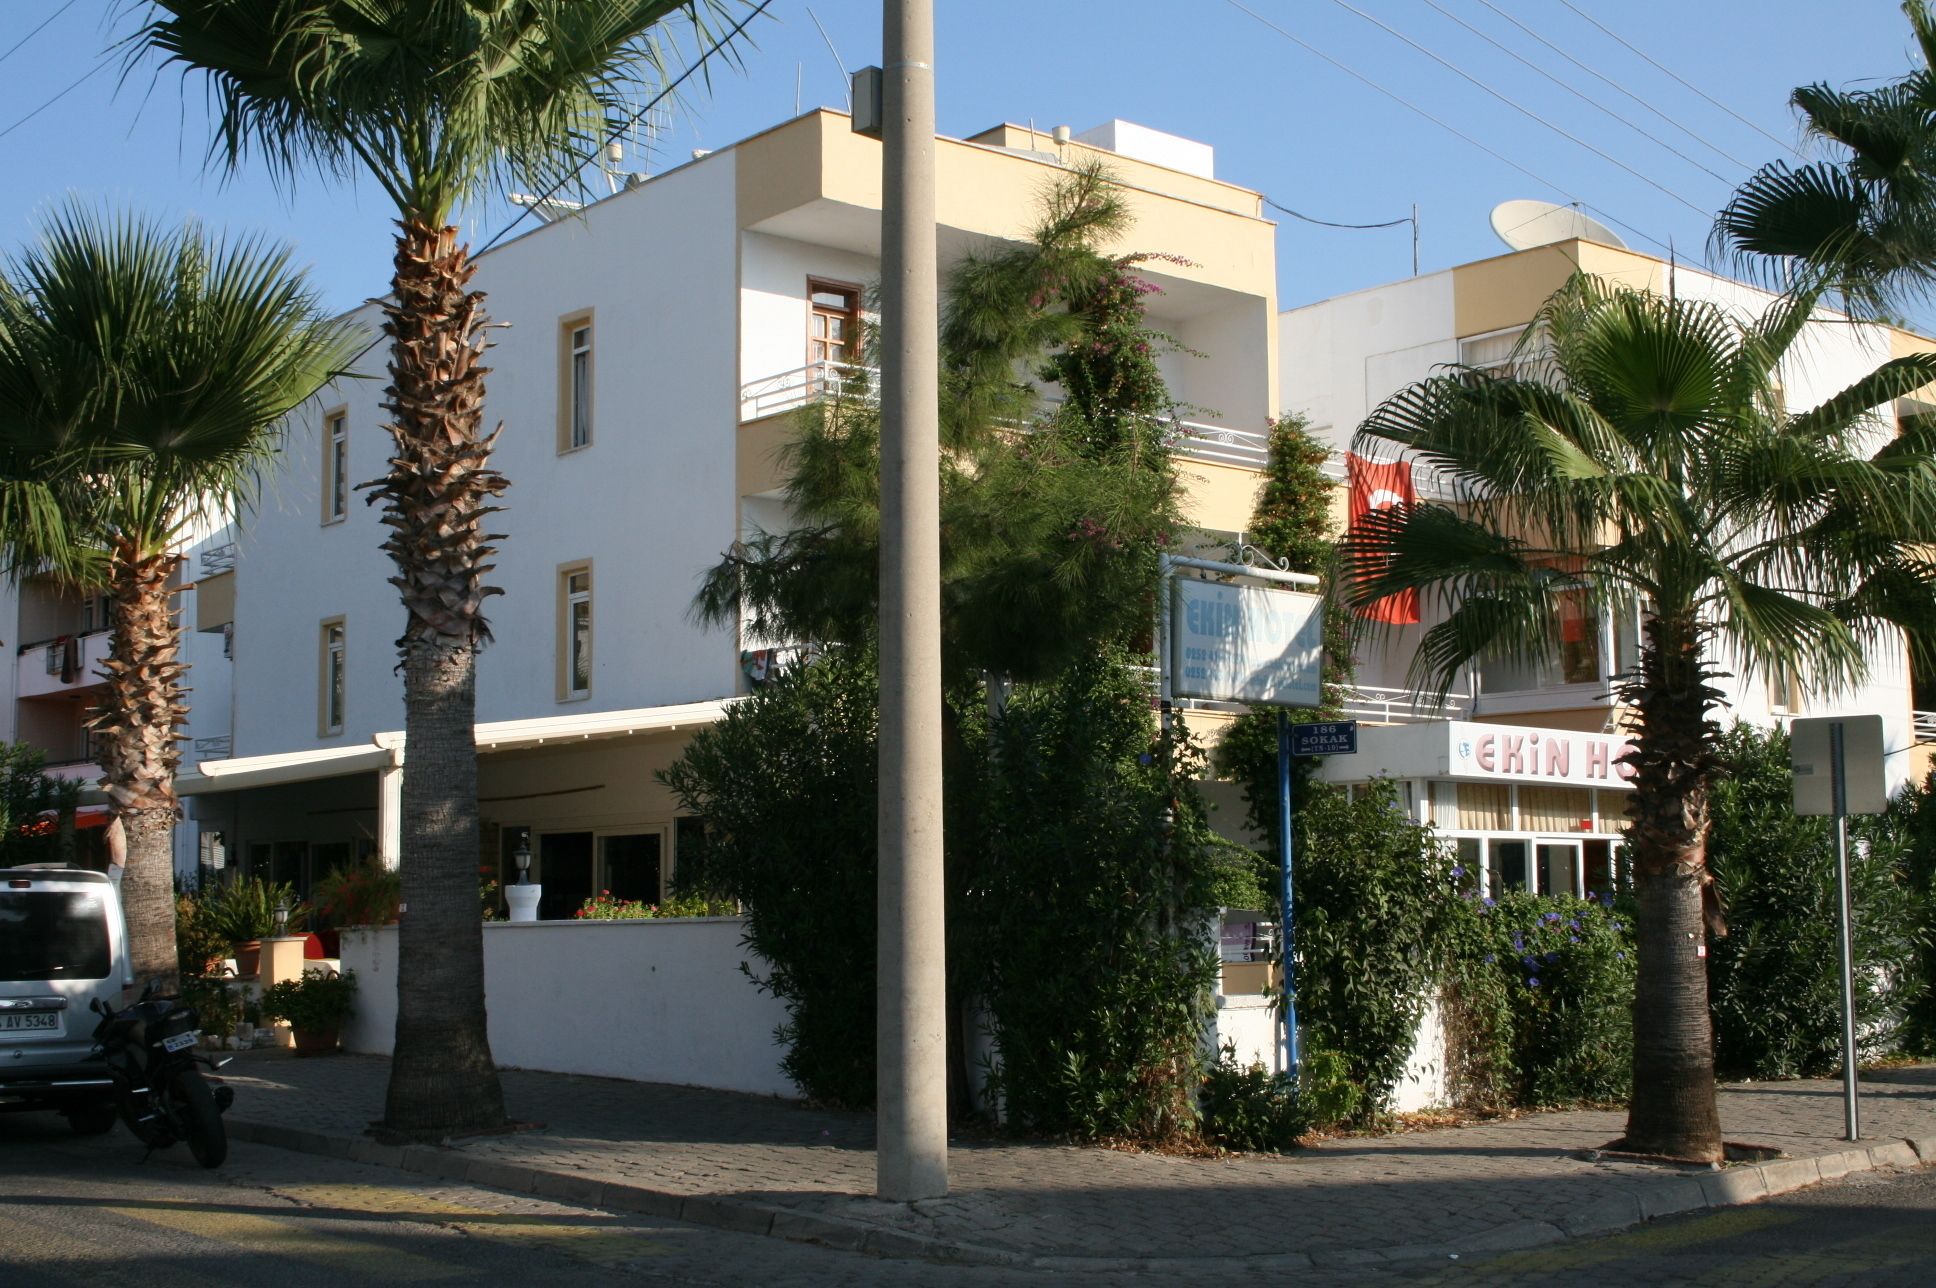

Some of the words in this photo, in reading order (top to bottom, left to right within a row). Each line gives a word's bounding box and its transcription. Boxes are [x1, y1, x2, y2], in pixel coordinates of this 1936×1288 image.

[1313, 725, 1336, 734] 186
[1301, 734, 1348, 745] SOKAK
[6, 1015, 21, 1028] AV
[25, 1014, 55, 1027] 5348
